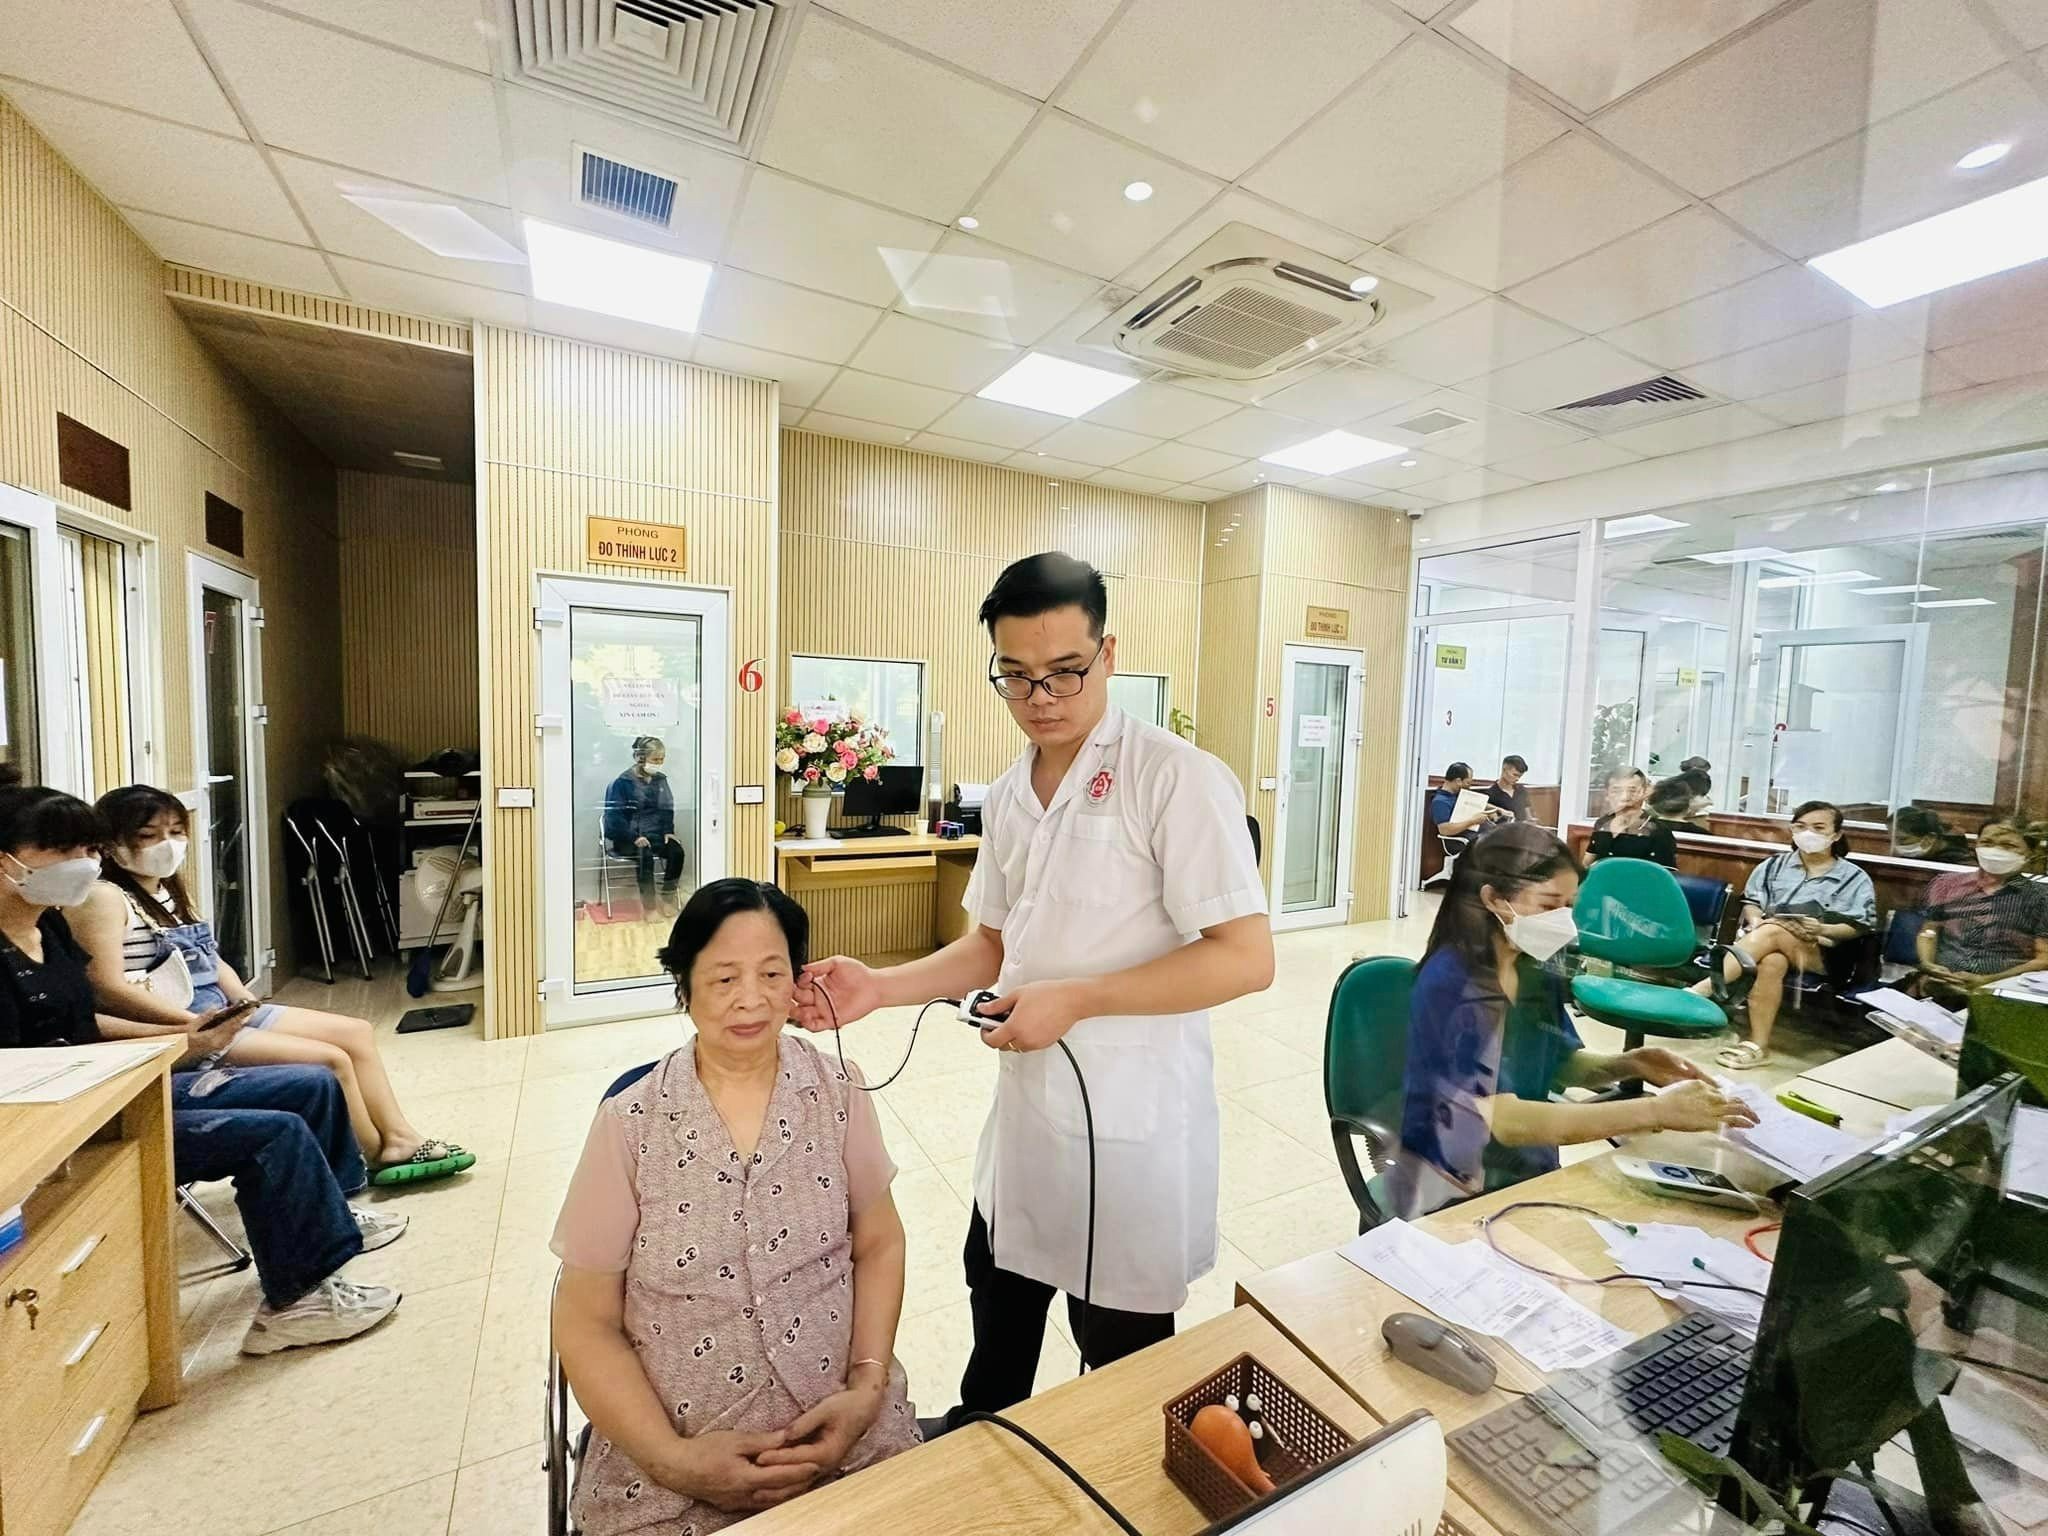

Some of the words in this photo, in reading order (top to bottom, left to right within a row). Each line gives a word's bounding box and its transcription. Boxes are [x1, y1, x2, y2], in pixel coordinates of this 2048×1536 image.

[598, 541, 613, 557] ĐO
[670, 548, 677, 563] 2
[738, 658, 763, 692] 6
[1266, 697, 1274, 717] 5
[1446, 710, 1452, 726] 3
